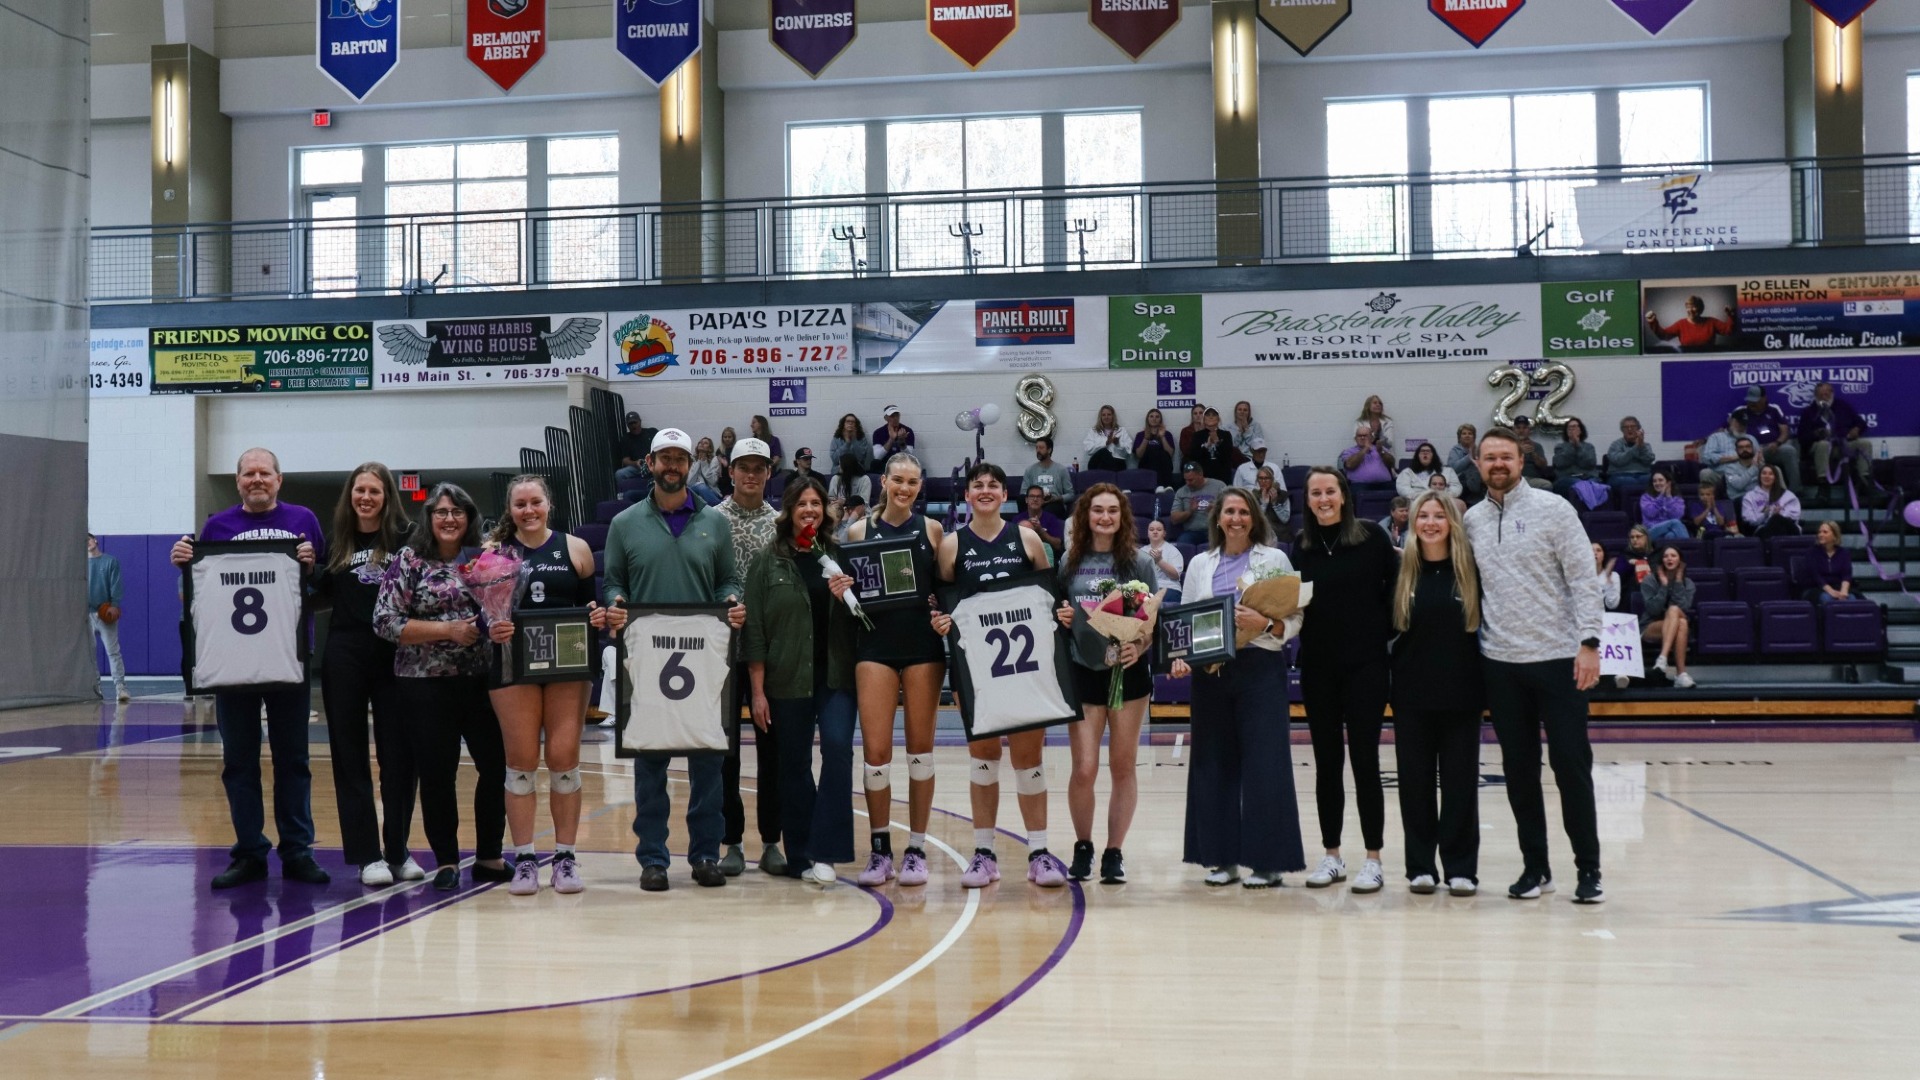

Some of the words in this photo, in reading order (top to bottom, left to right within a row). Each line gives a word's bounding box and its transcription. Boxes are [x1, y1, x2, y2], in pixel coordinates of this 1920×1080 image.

[933, 4, 1012, 21] EMMANUEL
[1101, 0, 1168, 11] ERSKINE
[1445, 0, 1508, 11] MARION
[775, 12, 853, 31] CONVERSE
[472, 30, 541, 47] BELMONT
[627, 23, 689, 39] CHOWAN
[331, 39, 387, 55] BARTON
[483, 45, 530, 61] ABBEY
[1627, 226, 1738, 238] CONFERENCE
[1627, 236, 1738, 249] CAROLINAS
[1741, 281, 1760, 291] JO
[1765, 279, 1810, 290] ELLEN
[1827, 275, 1900, 289] CENTURY
[1566, 289, 1615, 303] Golf
[1741, 290, 1827, 302] THORNTON
[1134, 302, 1176, 317] Spa
[689, 311, 767, 331] PAPA'S
[777, 308, 847, 328] PIZZA
[982, 310, 1024, 327] PANEL
[1028, 309, 1069, 326] BUILT
[1217, 308, 1416, 338] Brasstown
[1401, 301, 1526, 339] Valley
[153, 328, 240, 345] FRIENDS
[247, 326, 327, 343] MOVING
[332, 324, 370, 340] CO.
[445, 323, 485, 336] YOUNG
[489, 322, 533, 335] HARRIS
[613, 313, 650, 346] PAPA'S
[651, 317, 677, 341] PIZZA
[441, 339, 483, 354] WING
[489, 337, 538, 353] HOUSE
[717, 335, 743, 345] Pick-up
[744, 334, 772, 343] Window,
[783, 334, 795, 342] We
[796, 333, 820, 341] Deliver
[822, 332, 830, 341] To
[831, 332, 849, 340] You!
[1276, 335, 1382, 346] RESORT
[1387, 332, 1411, 345] &
[1420, 333, 1466, 343] SPA
[1549, 336, 1635, 350] Stables
[1764, 334, 1782, 349] Go
[1790, 333, 1853, 349] Mountain
[1859, 331, 1902, 347] Lions!
[174, 352, 229, 364] FRIENDS
[263, 347, 369, 365] 706-896-7720
[1122, 348, 1191, 363] Dining
[1255, 347, 1488, 361] www.BrasstownValley.com
[268, 367, 314, 377] RESIDENTIAL
[320, 365, 370, 376] COMMERCIAL
[380, 372, 410, 384] 1149
[418, 370, 450, 382] Main
[457, 370, 475, 381] St.
[690, 368, 708, 376] Only
[711, 367, 717, 375] 5
[720, 365, 752, 374] Minutes
[755, 364, 775, 374] Away
[784, 363, 831, 373] Hiawassee,
[1733, 368, 1822, 385] MOUNTAIN
[1828, 368, 1869, 381] LION
[287, 378, 305, 389] FREE
[308, 377, 350, 388] ESTIMATES
[772, 379, 804, 387] SECTION
[1170, 379, 1182, 393] B
[1842, 384, 1867, 393] CLUB
[781, 387, 794, 401] A
[402, 476, 418, 489] EXIT
[537, 563, 569, 571] Harris
[964, 559, 991, 571] Young
[993, 556, 1022, 564] Harris
[220, 572, 246, 586] YOUNG
[248, 571, 276, 585] HARRIS
[850, 556, 882, 590] YH
[530, 581, 545, 603] 8
[231, 586, 268, 635] 8
[979, 612, 1003, 627] YOUNG
[1005, 608, 1032, 624] HARRIS
[1163, 619, 1191, 650] YH
[524, 626, 554, 660] YH
[652, 635, 676, 649] YOUNG
[679, 636, 705, 650] HARRIS
[985, 624, 1039, 678] 22
[659, 652, 695, 700] 6
